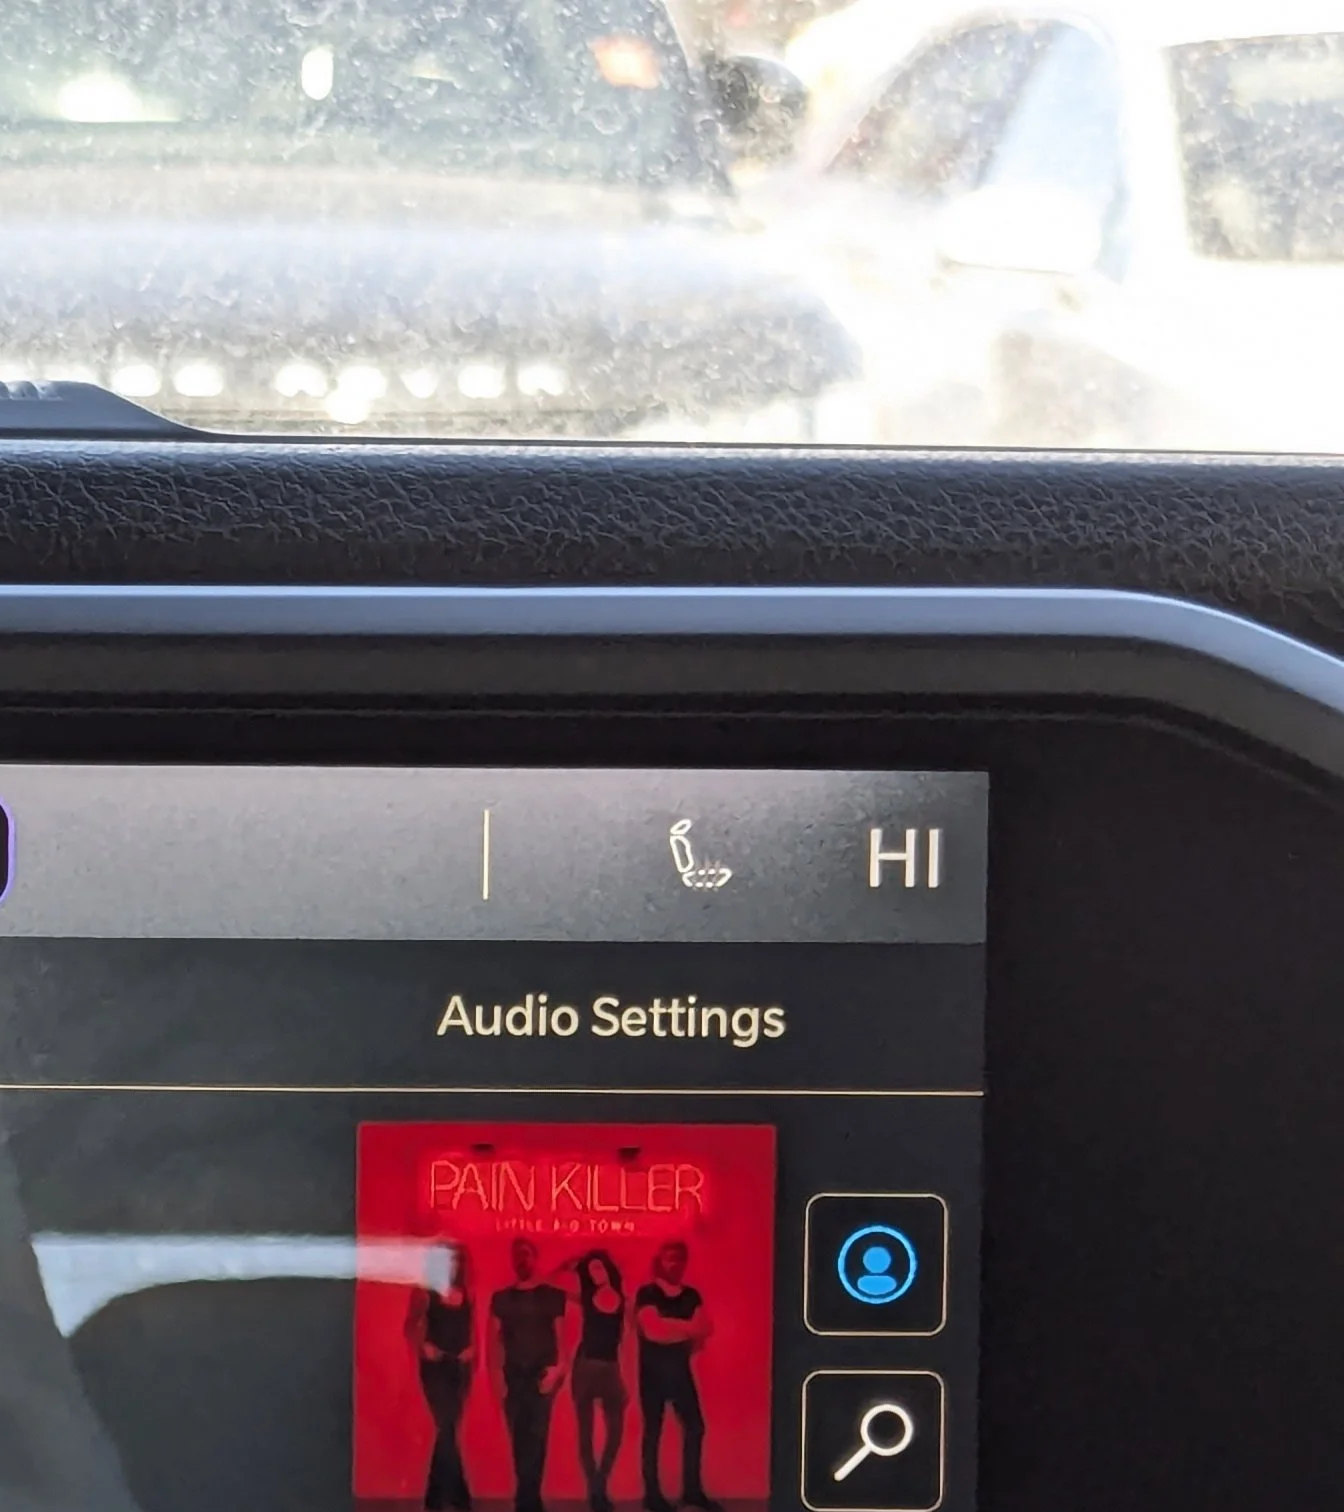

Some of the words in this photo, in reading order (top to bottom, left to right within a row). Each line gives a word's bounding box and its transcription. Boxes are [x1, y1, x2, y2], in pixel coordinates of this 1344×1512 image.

[867, 828, 942, 889] HI
[436, 993, 580, 1038] Audio
[590, 995, 787, 1048] Settings
[429, 1159, 535, 1212] PAIN
[550, 1162, 706, 1214] KILLER
